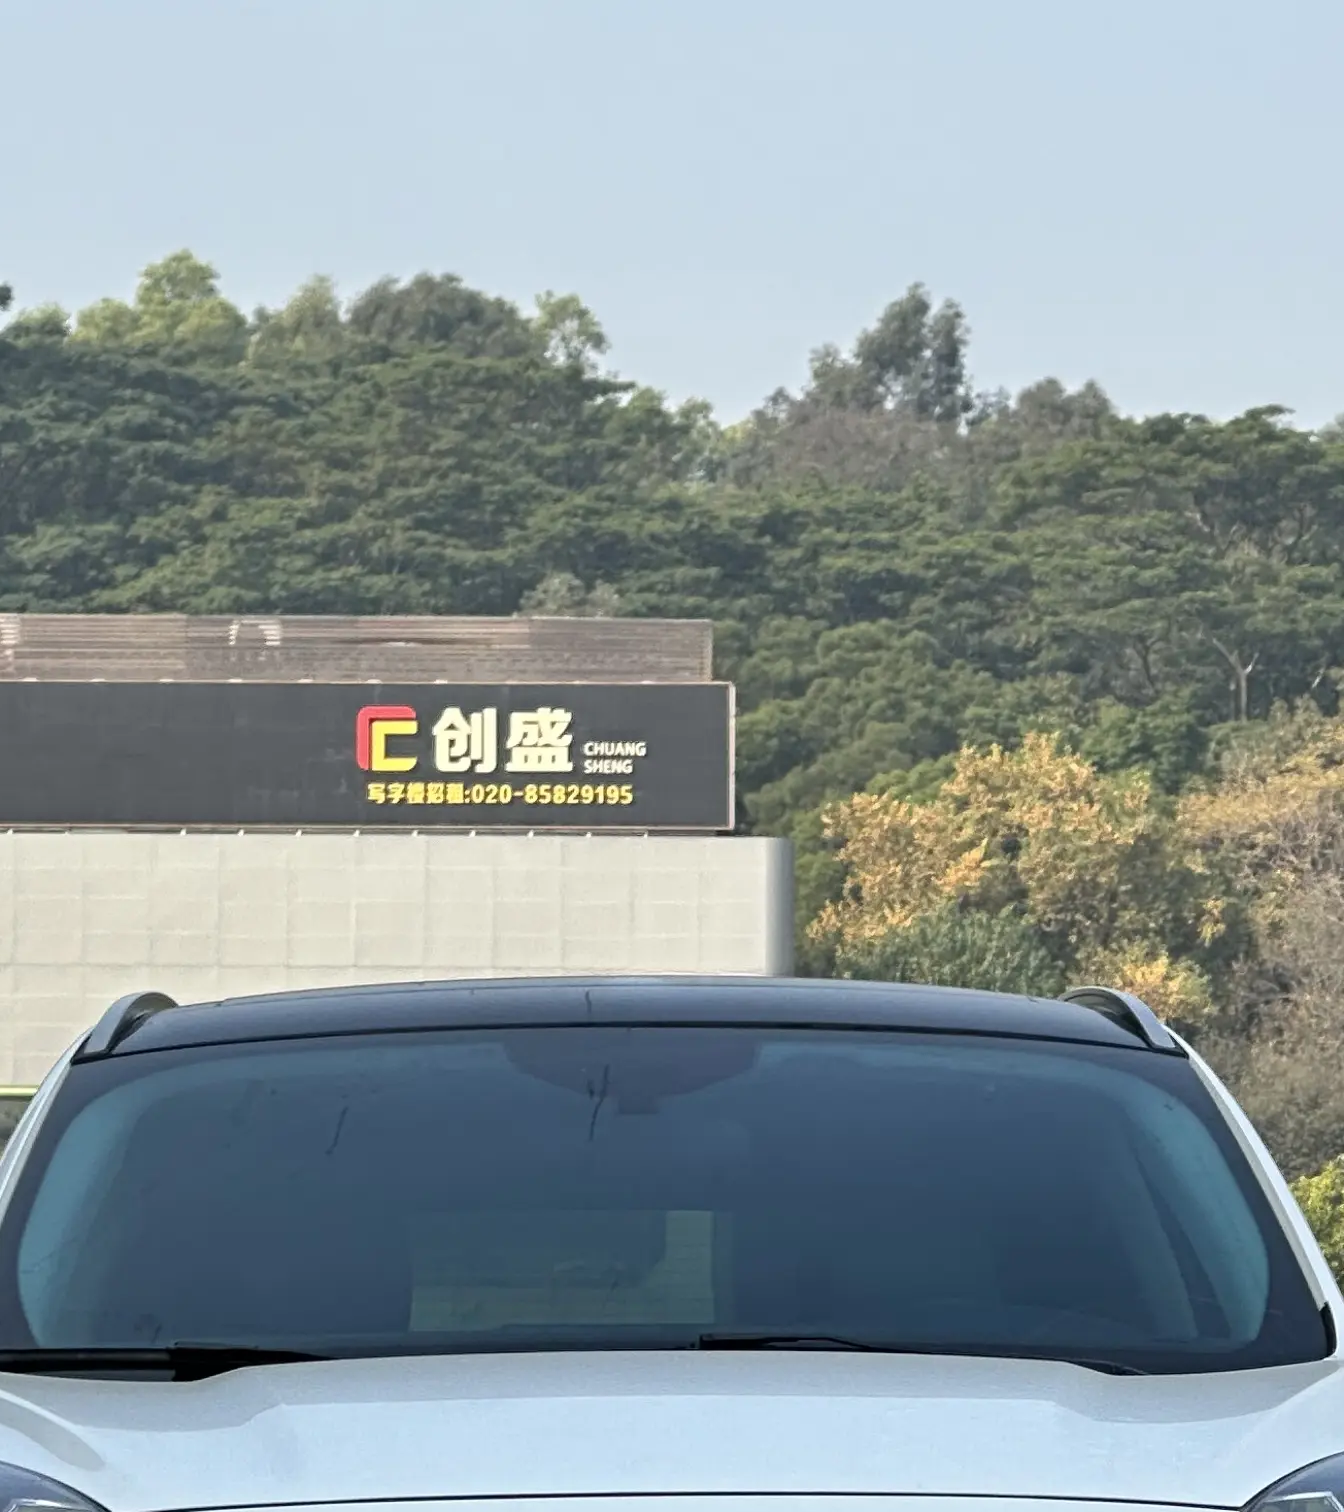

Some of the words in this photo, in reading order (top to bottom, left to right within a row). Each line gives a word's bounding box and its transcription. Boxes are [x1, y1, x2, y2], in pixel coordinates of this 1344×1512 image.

[432, 706, 573, 773] 创盛
[583, 741, 646, 757] CHUANG
[583, 759, 633, 774] SHENG
